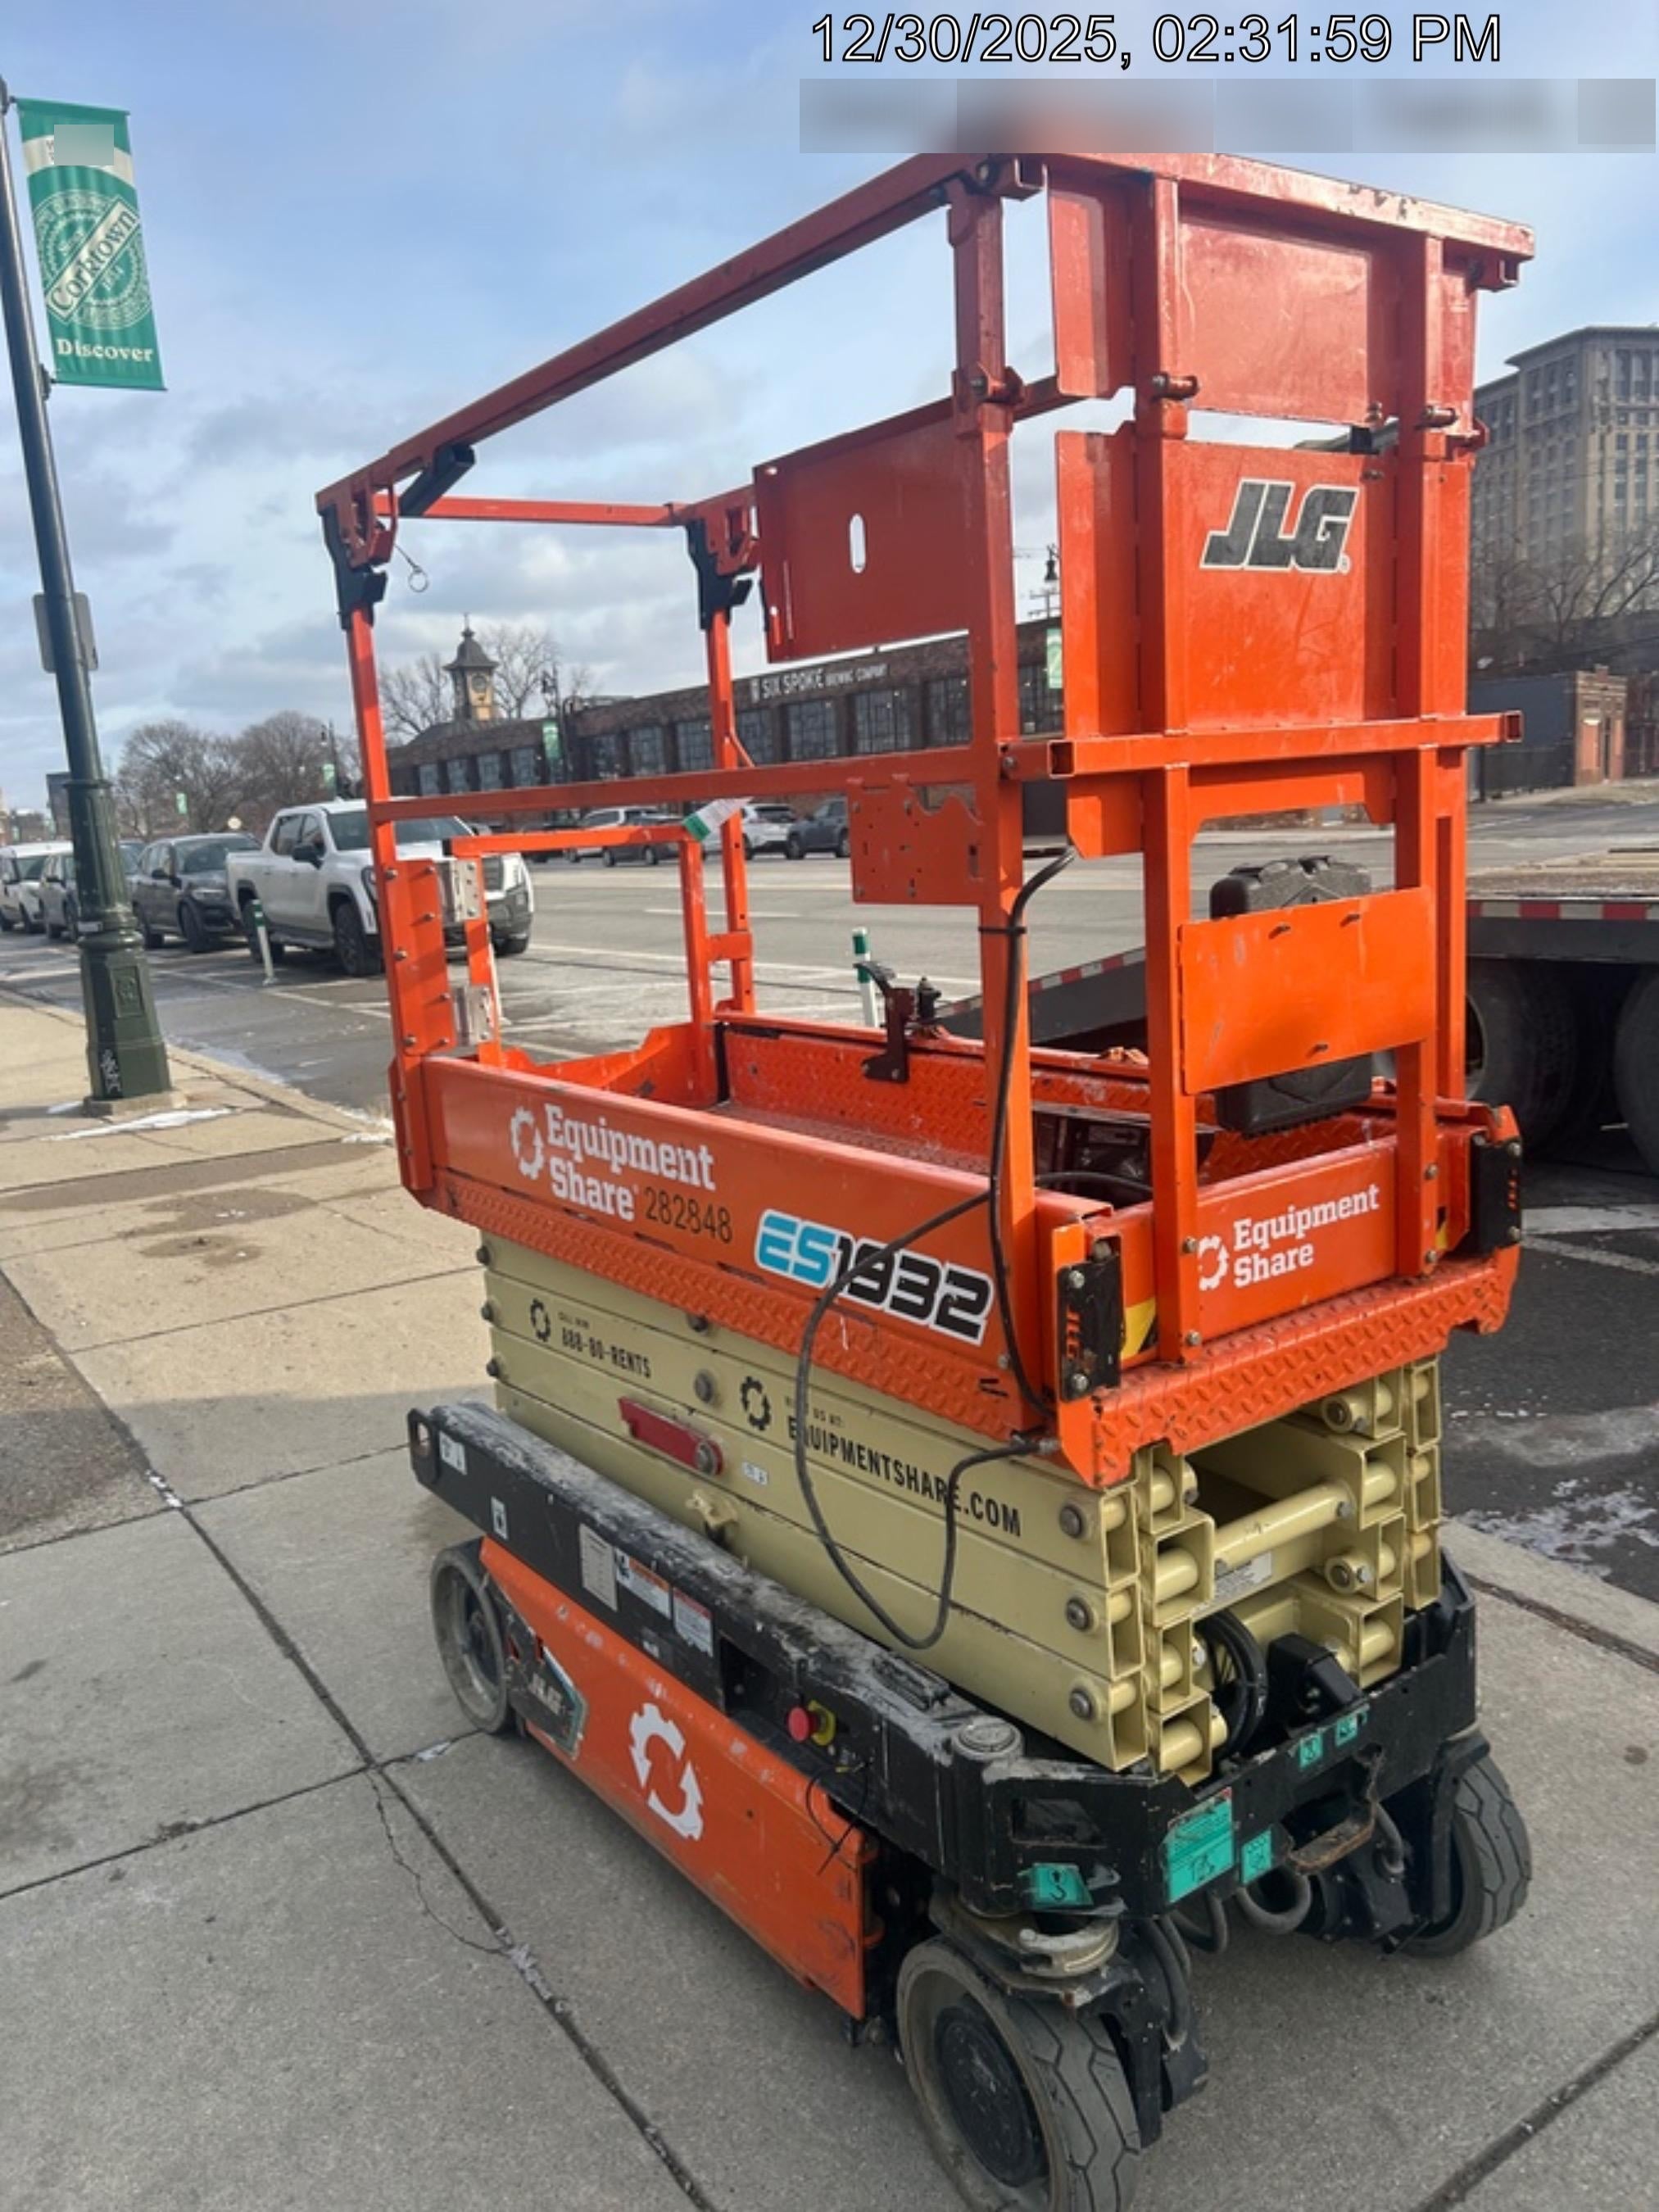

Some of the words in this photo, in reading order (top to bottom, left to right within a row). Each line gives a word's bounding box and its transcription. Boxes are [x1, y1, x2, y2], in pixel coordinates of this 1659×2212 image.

[51, 211, 137, 310] Corktown
[56, 338, 153, 361] Discover
[1200, 478, 1360, 573] JLG
[545, 1103, 716, 1190] Equipment
[550, 1157, 635, 1222] Share
[644, 1186, 733, 1244] 282848
[1233, 1183, 1380, 1252] Equipment
[1233, 1243, 1314, 1288] Share
[788, 1416, 1022, 1538] EUIPMENTSHARE.COM
